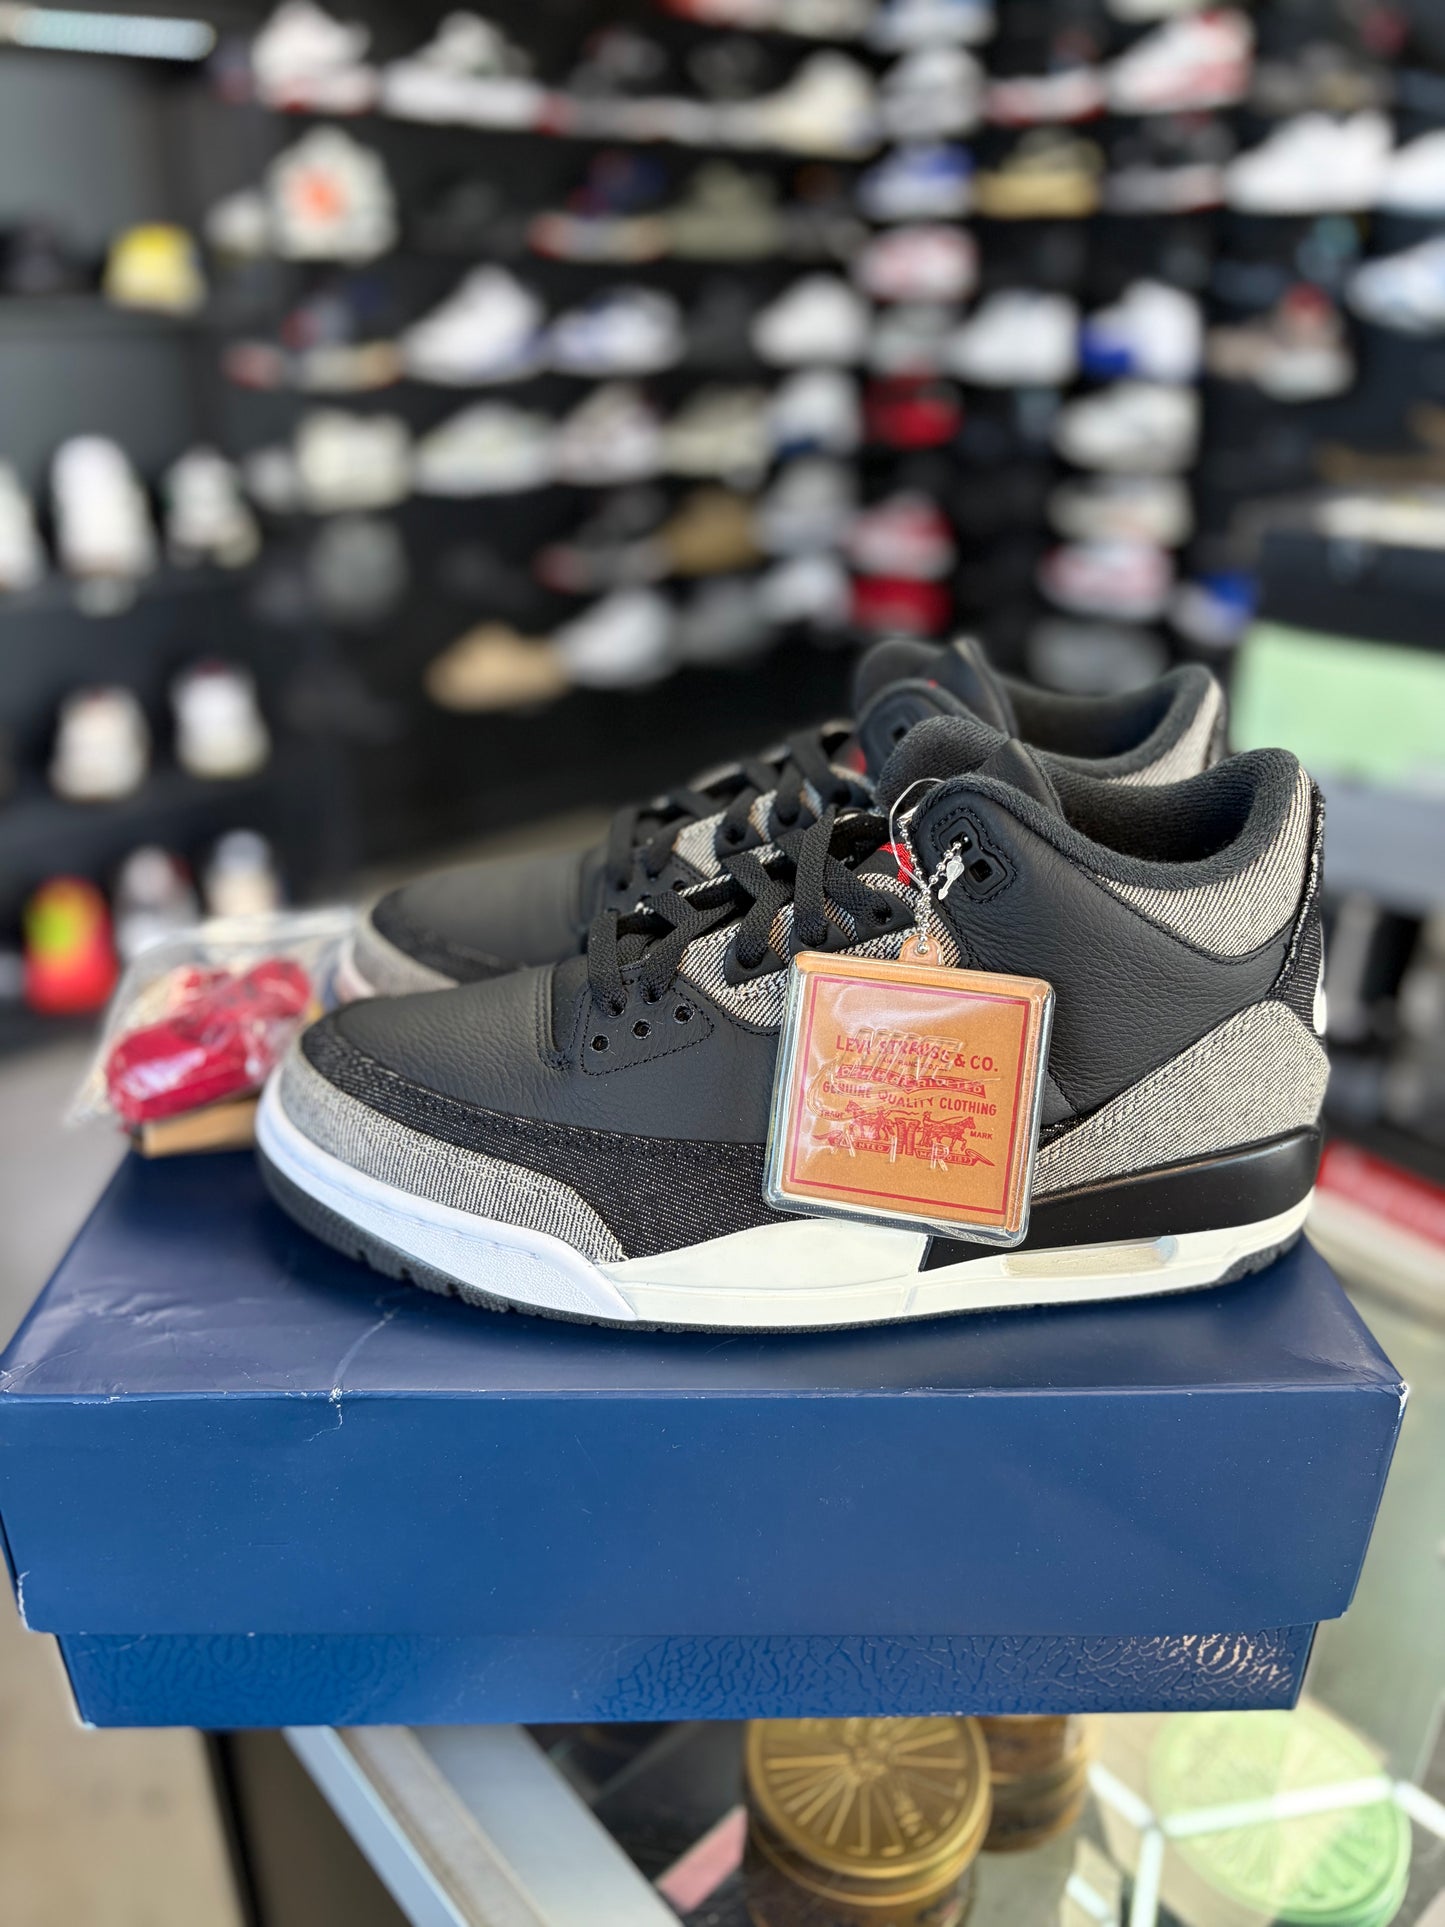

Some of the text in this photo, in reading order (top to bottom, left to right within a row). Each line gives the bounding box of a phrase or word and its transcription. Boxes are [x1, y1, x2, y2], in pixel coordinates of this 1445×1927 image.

[836, 1034, 871, 1055] LEVI
[954, 1053, 966, 1068] &
[970, 1055, 998, 1072] CO.
[822, 1080, 997, 1117] GENUINE QUALITY CLOTHING
[970, 1130, 993, 1140] MARK
